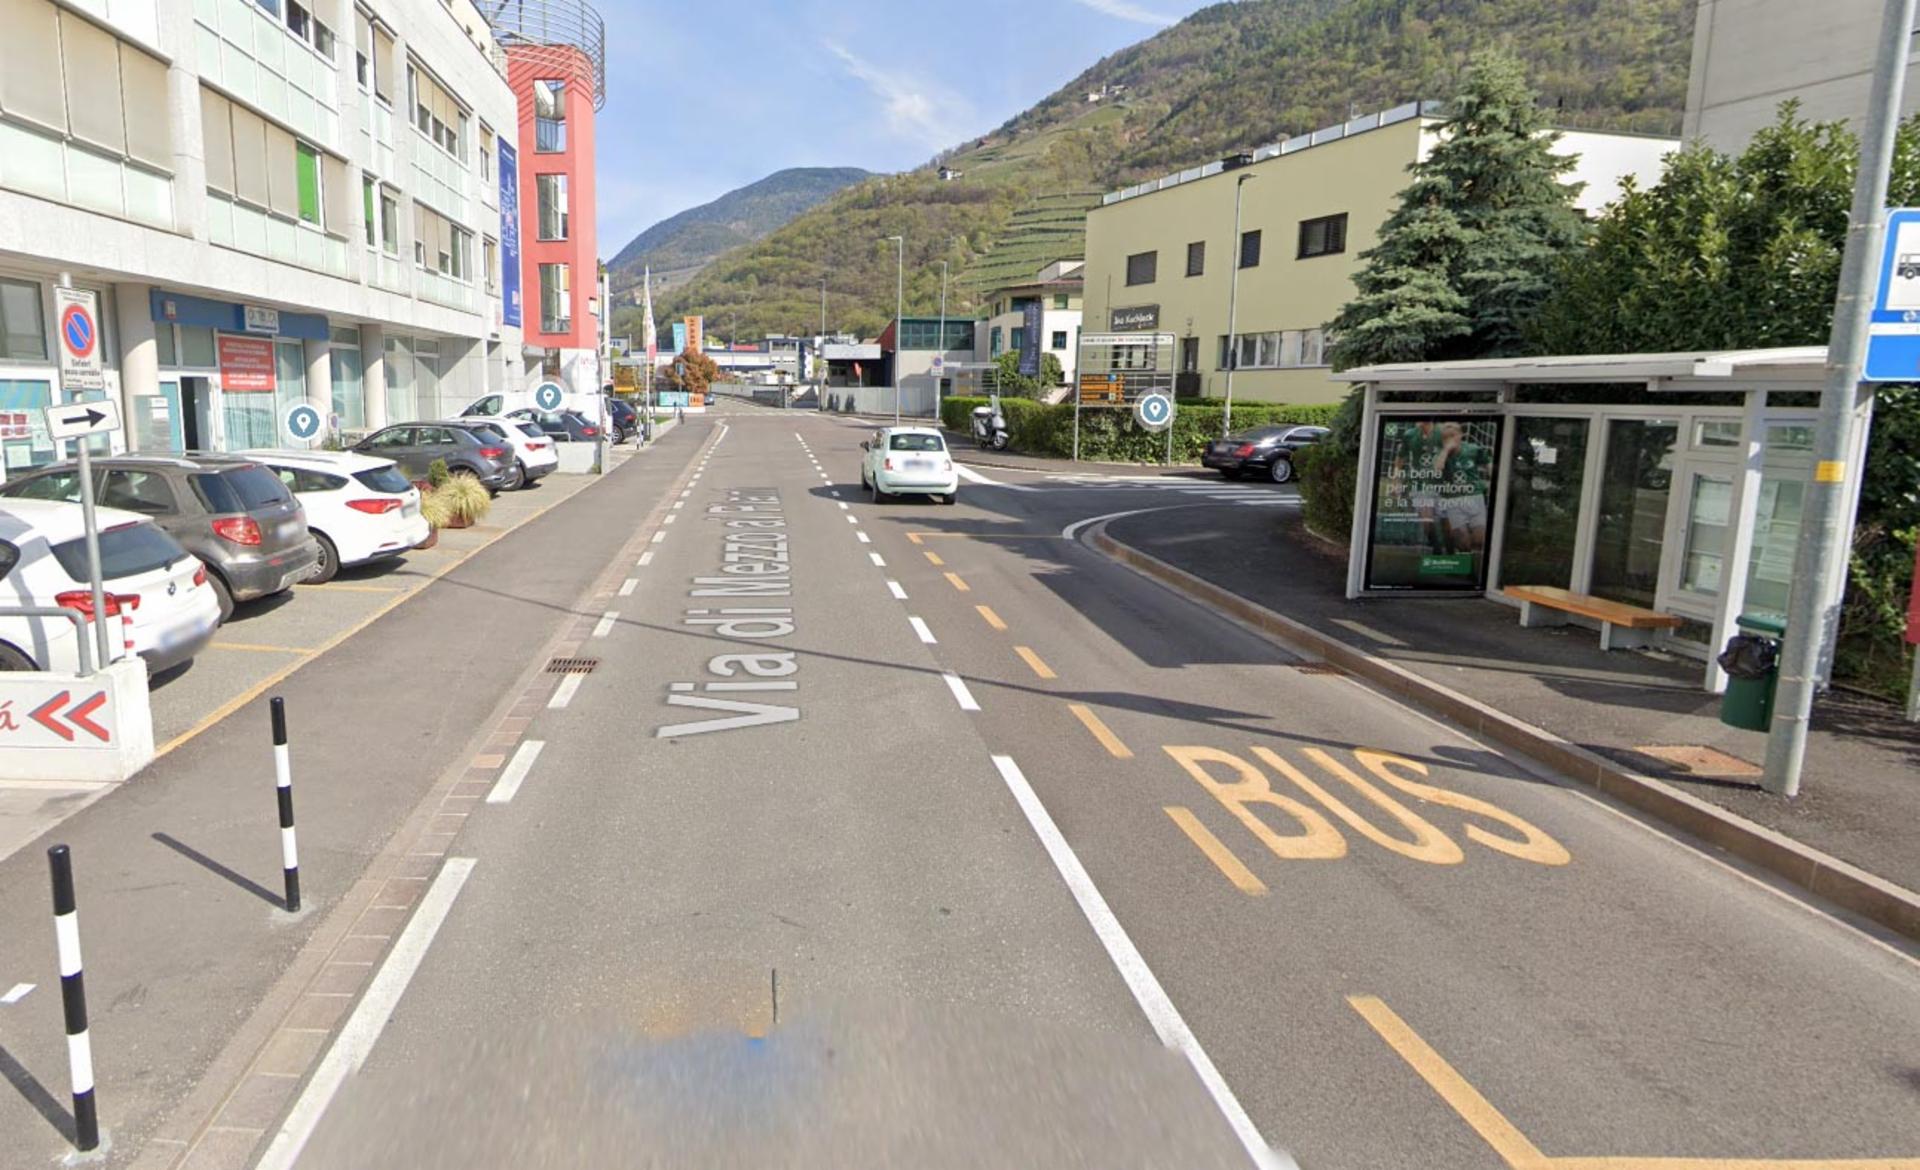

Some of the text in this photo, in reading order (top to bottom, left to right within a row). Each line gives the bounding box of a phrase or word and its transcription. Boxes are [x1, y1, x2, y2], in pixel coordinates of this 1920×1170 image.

[1388, 465, 1442, 479] Un bene
[1386, 480, 1474, 496] per il territorio
[1384, 498, 1393, 508] e
[1397, 496, 1408, 508] la
[1161, 745, 1572, 866] BUS
